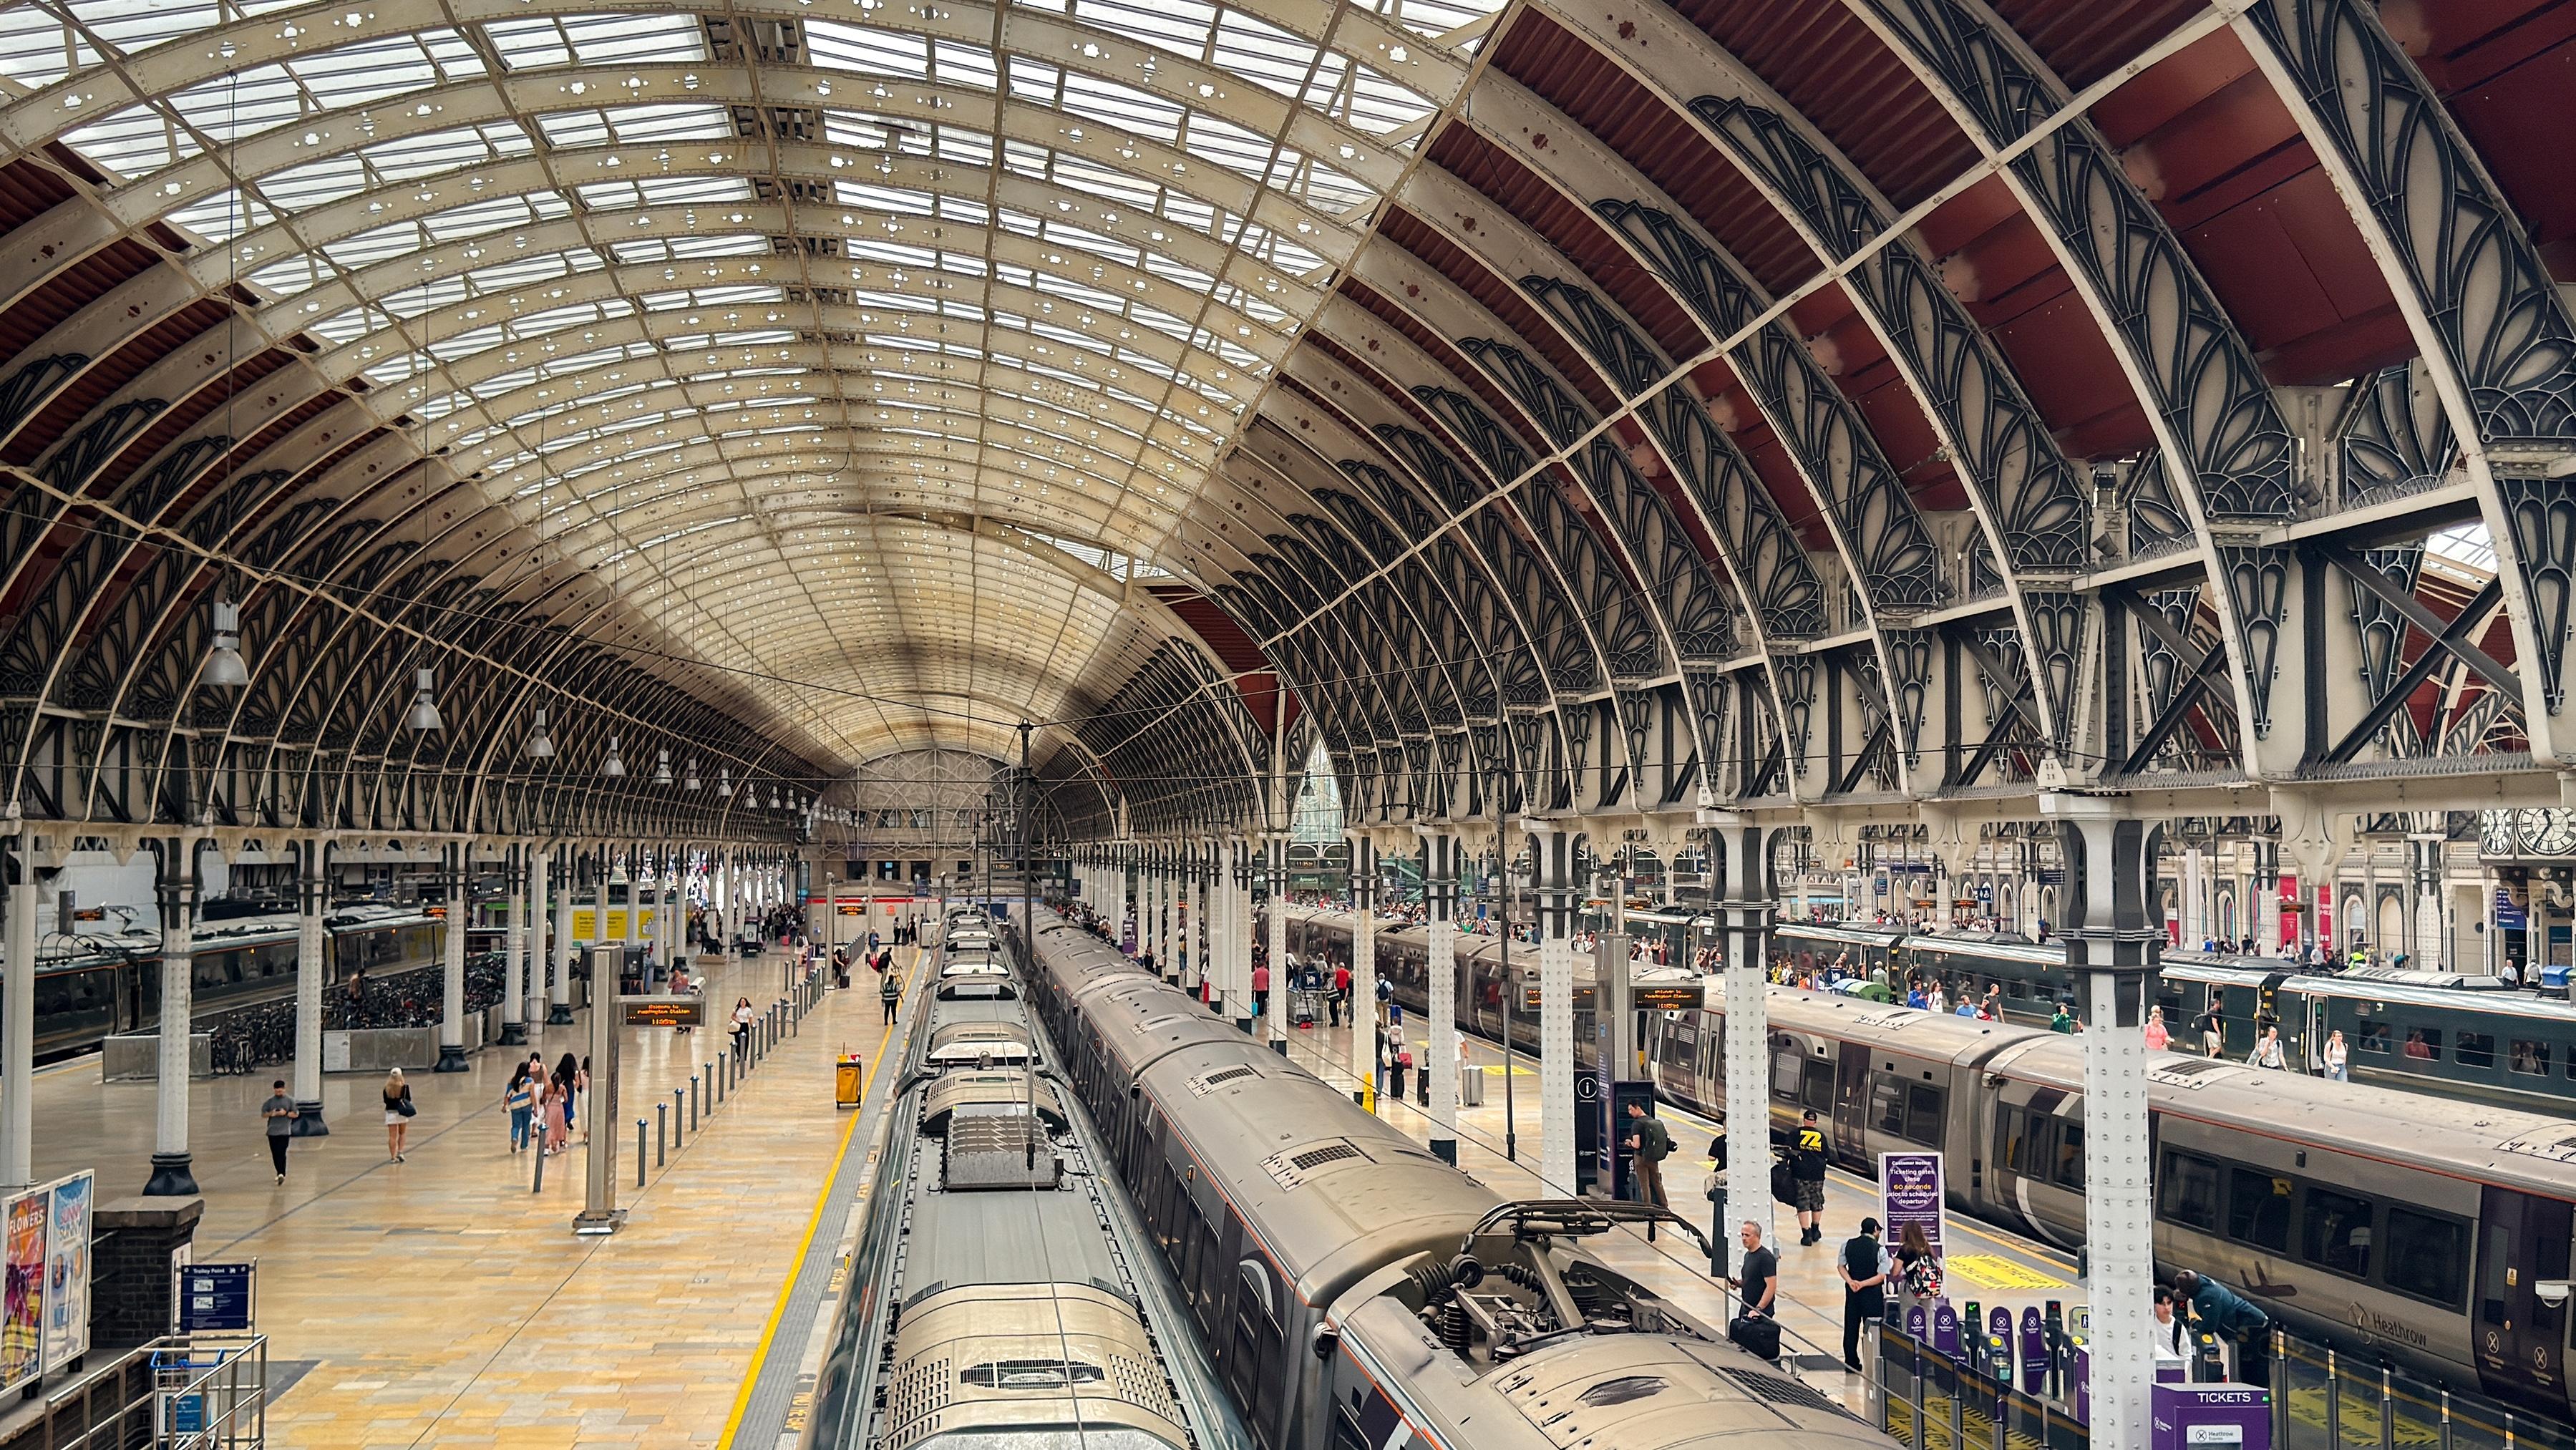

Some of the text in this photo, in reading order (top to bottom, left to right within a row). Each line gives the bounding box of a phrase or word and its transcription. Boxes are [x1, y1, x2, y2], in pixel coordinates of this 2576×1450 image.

[1799, 1130, 1822, 1147] 72
[9, 1209, 44, 1236] FLOWERS
[2372, 1313, 2427, 1346] Heathrow
[2197, 1392, 2251, 1403] TICKETS
